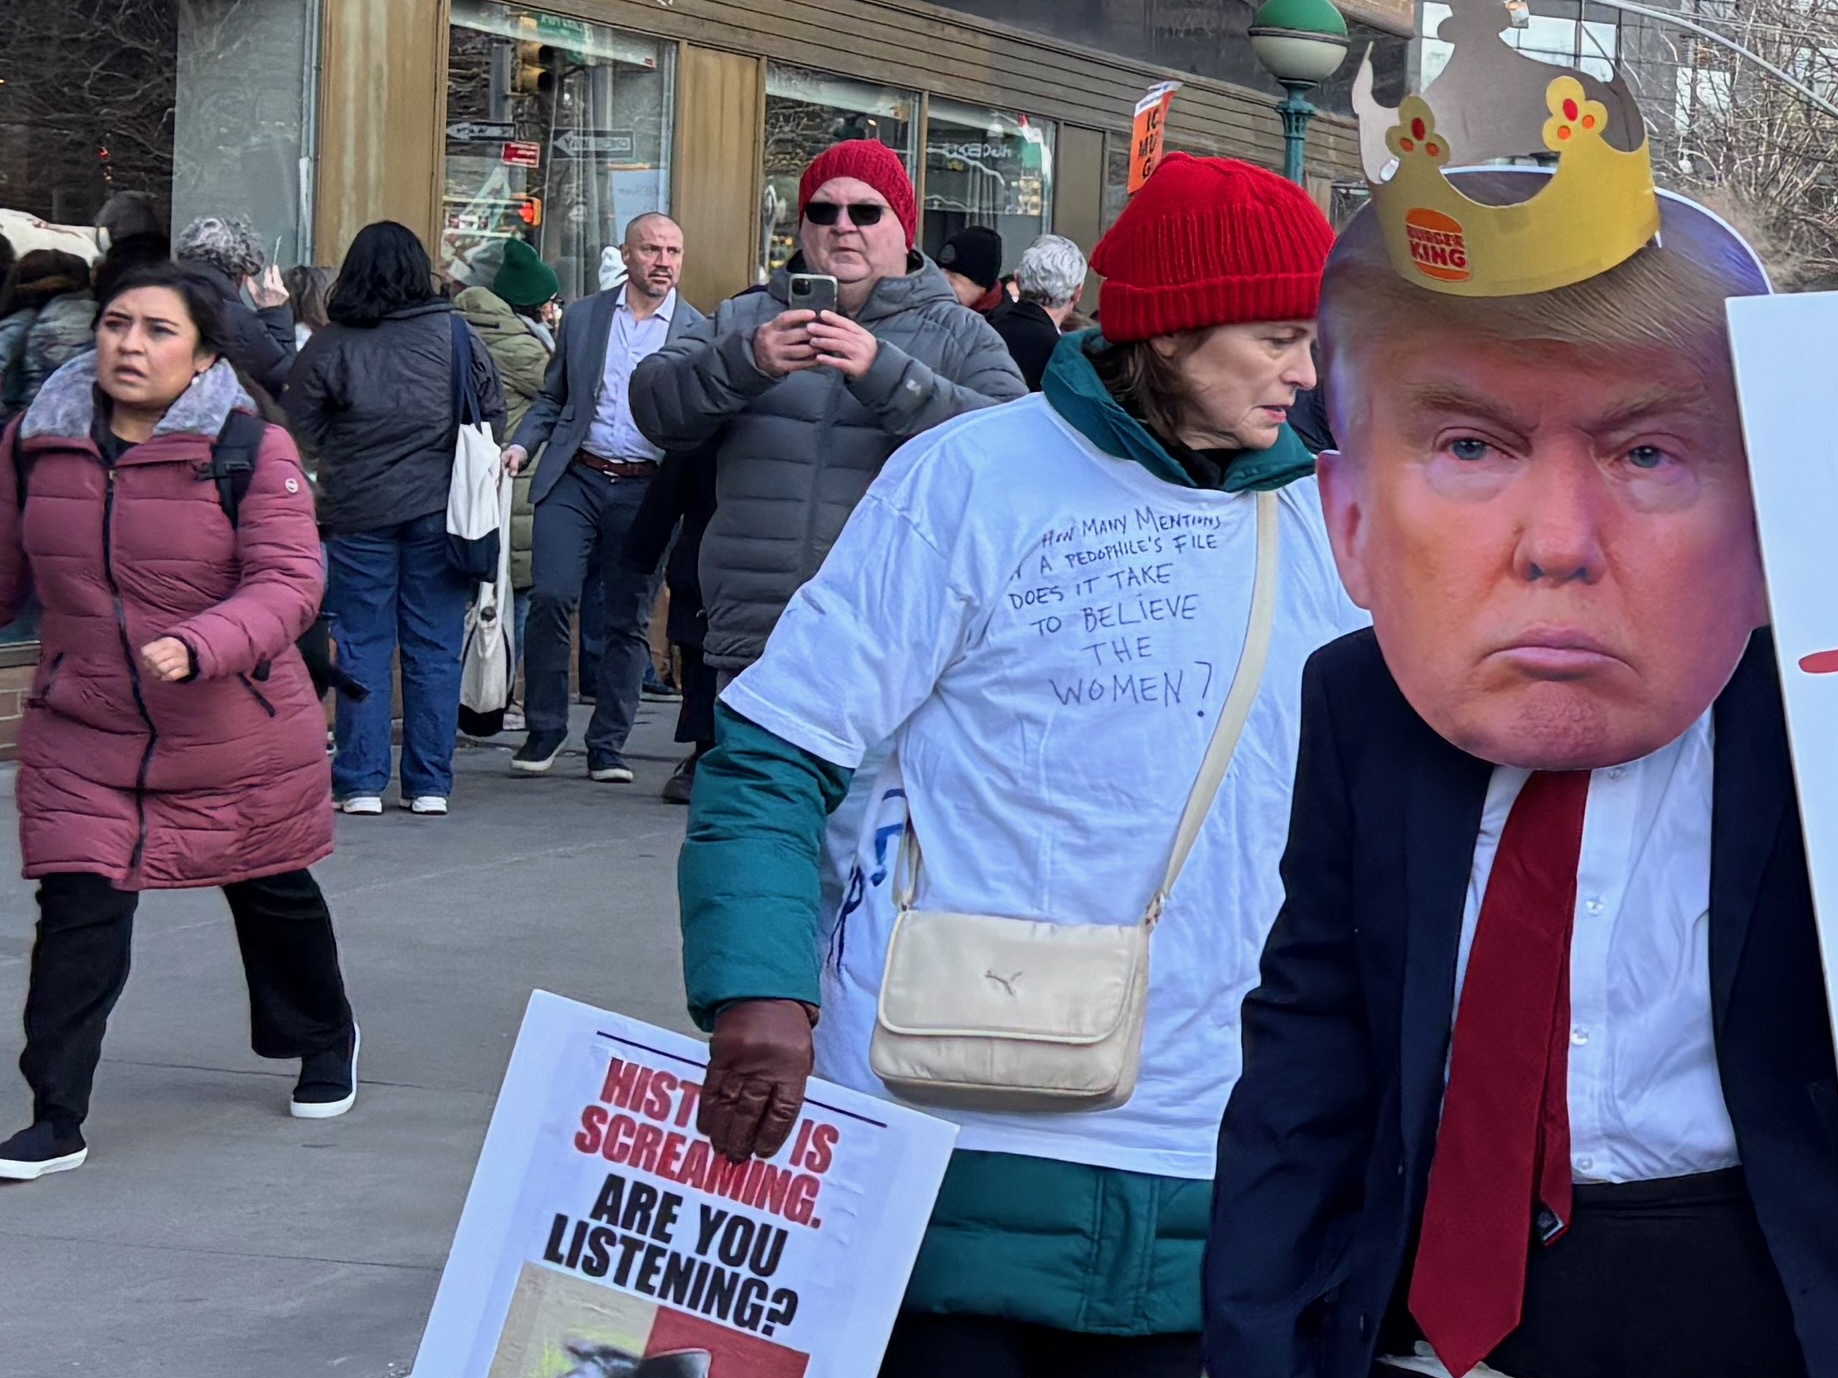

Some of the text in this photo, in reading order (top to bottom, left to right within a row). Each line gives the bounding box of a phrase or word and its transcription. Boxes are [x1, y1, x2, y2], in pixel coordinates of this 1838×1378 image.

[1409, 239, 1467, 269] KING
[1082, 514, 1127, 538] MANY
[1040, 554, 1053, 575] A
[1064, 536, 1163, 569] PEDOPHILE'S
[1171, 533, 1218, 554] FILE
[1007, 562, 1174, 610] DOES IT TAKE
[1029, 615, 1062, 637] TO
[1079, 635, 1153, 667] THE
[574, 1103, 822, 1229] SCREAMING.
[789, 1117, 840, 1175] IS
[589, 1172, 789, 1279] ARE YOU
[542, 1212, 800, 1338] LISTENING?
